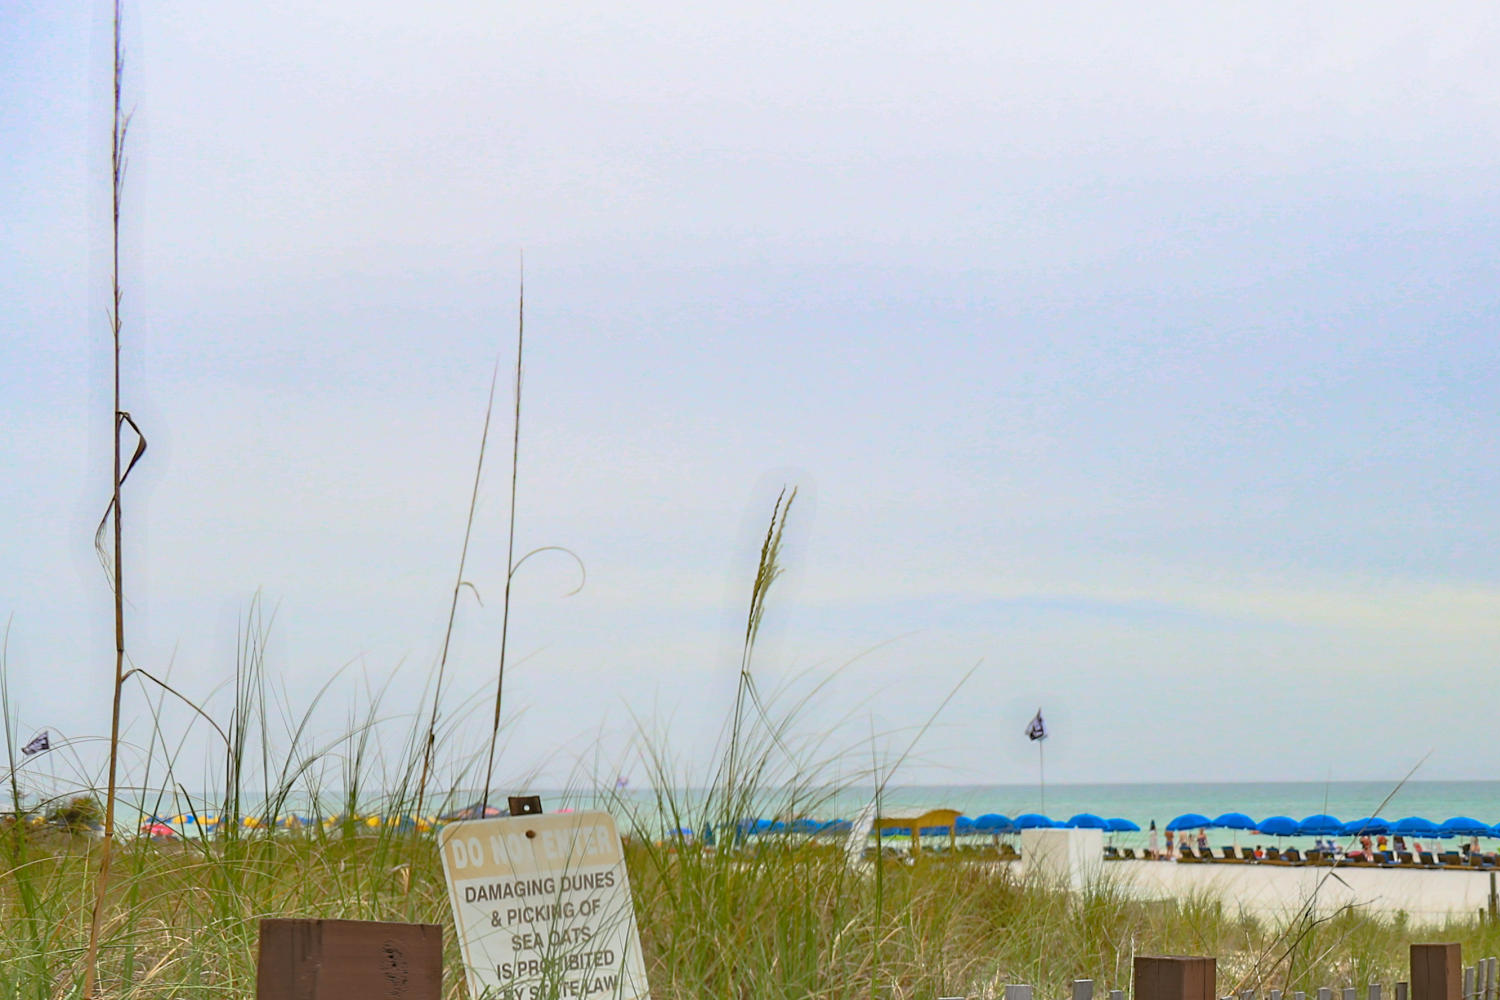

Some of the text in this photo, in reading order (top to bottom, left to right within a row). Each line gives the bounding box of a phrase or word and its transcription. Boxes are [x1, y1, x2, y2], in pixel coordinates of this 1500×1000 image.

[452, 827, 611, 869] DO NOT ENTER
[465, 871, 615, 903] DAMAGING DUNES
[491, 899, 601, 927] & PICKING OF
[511, 926, 592, 951] SEA OATS
[497, 963, 513, 980] IS
[584, 975, 619, 994] LAW
